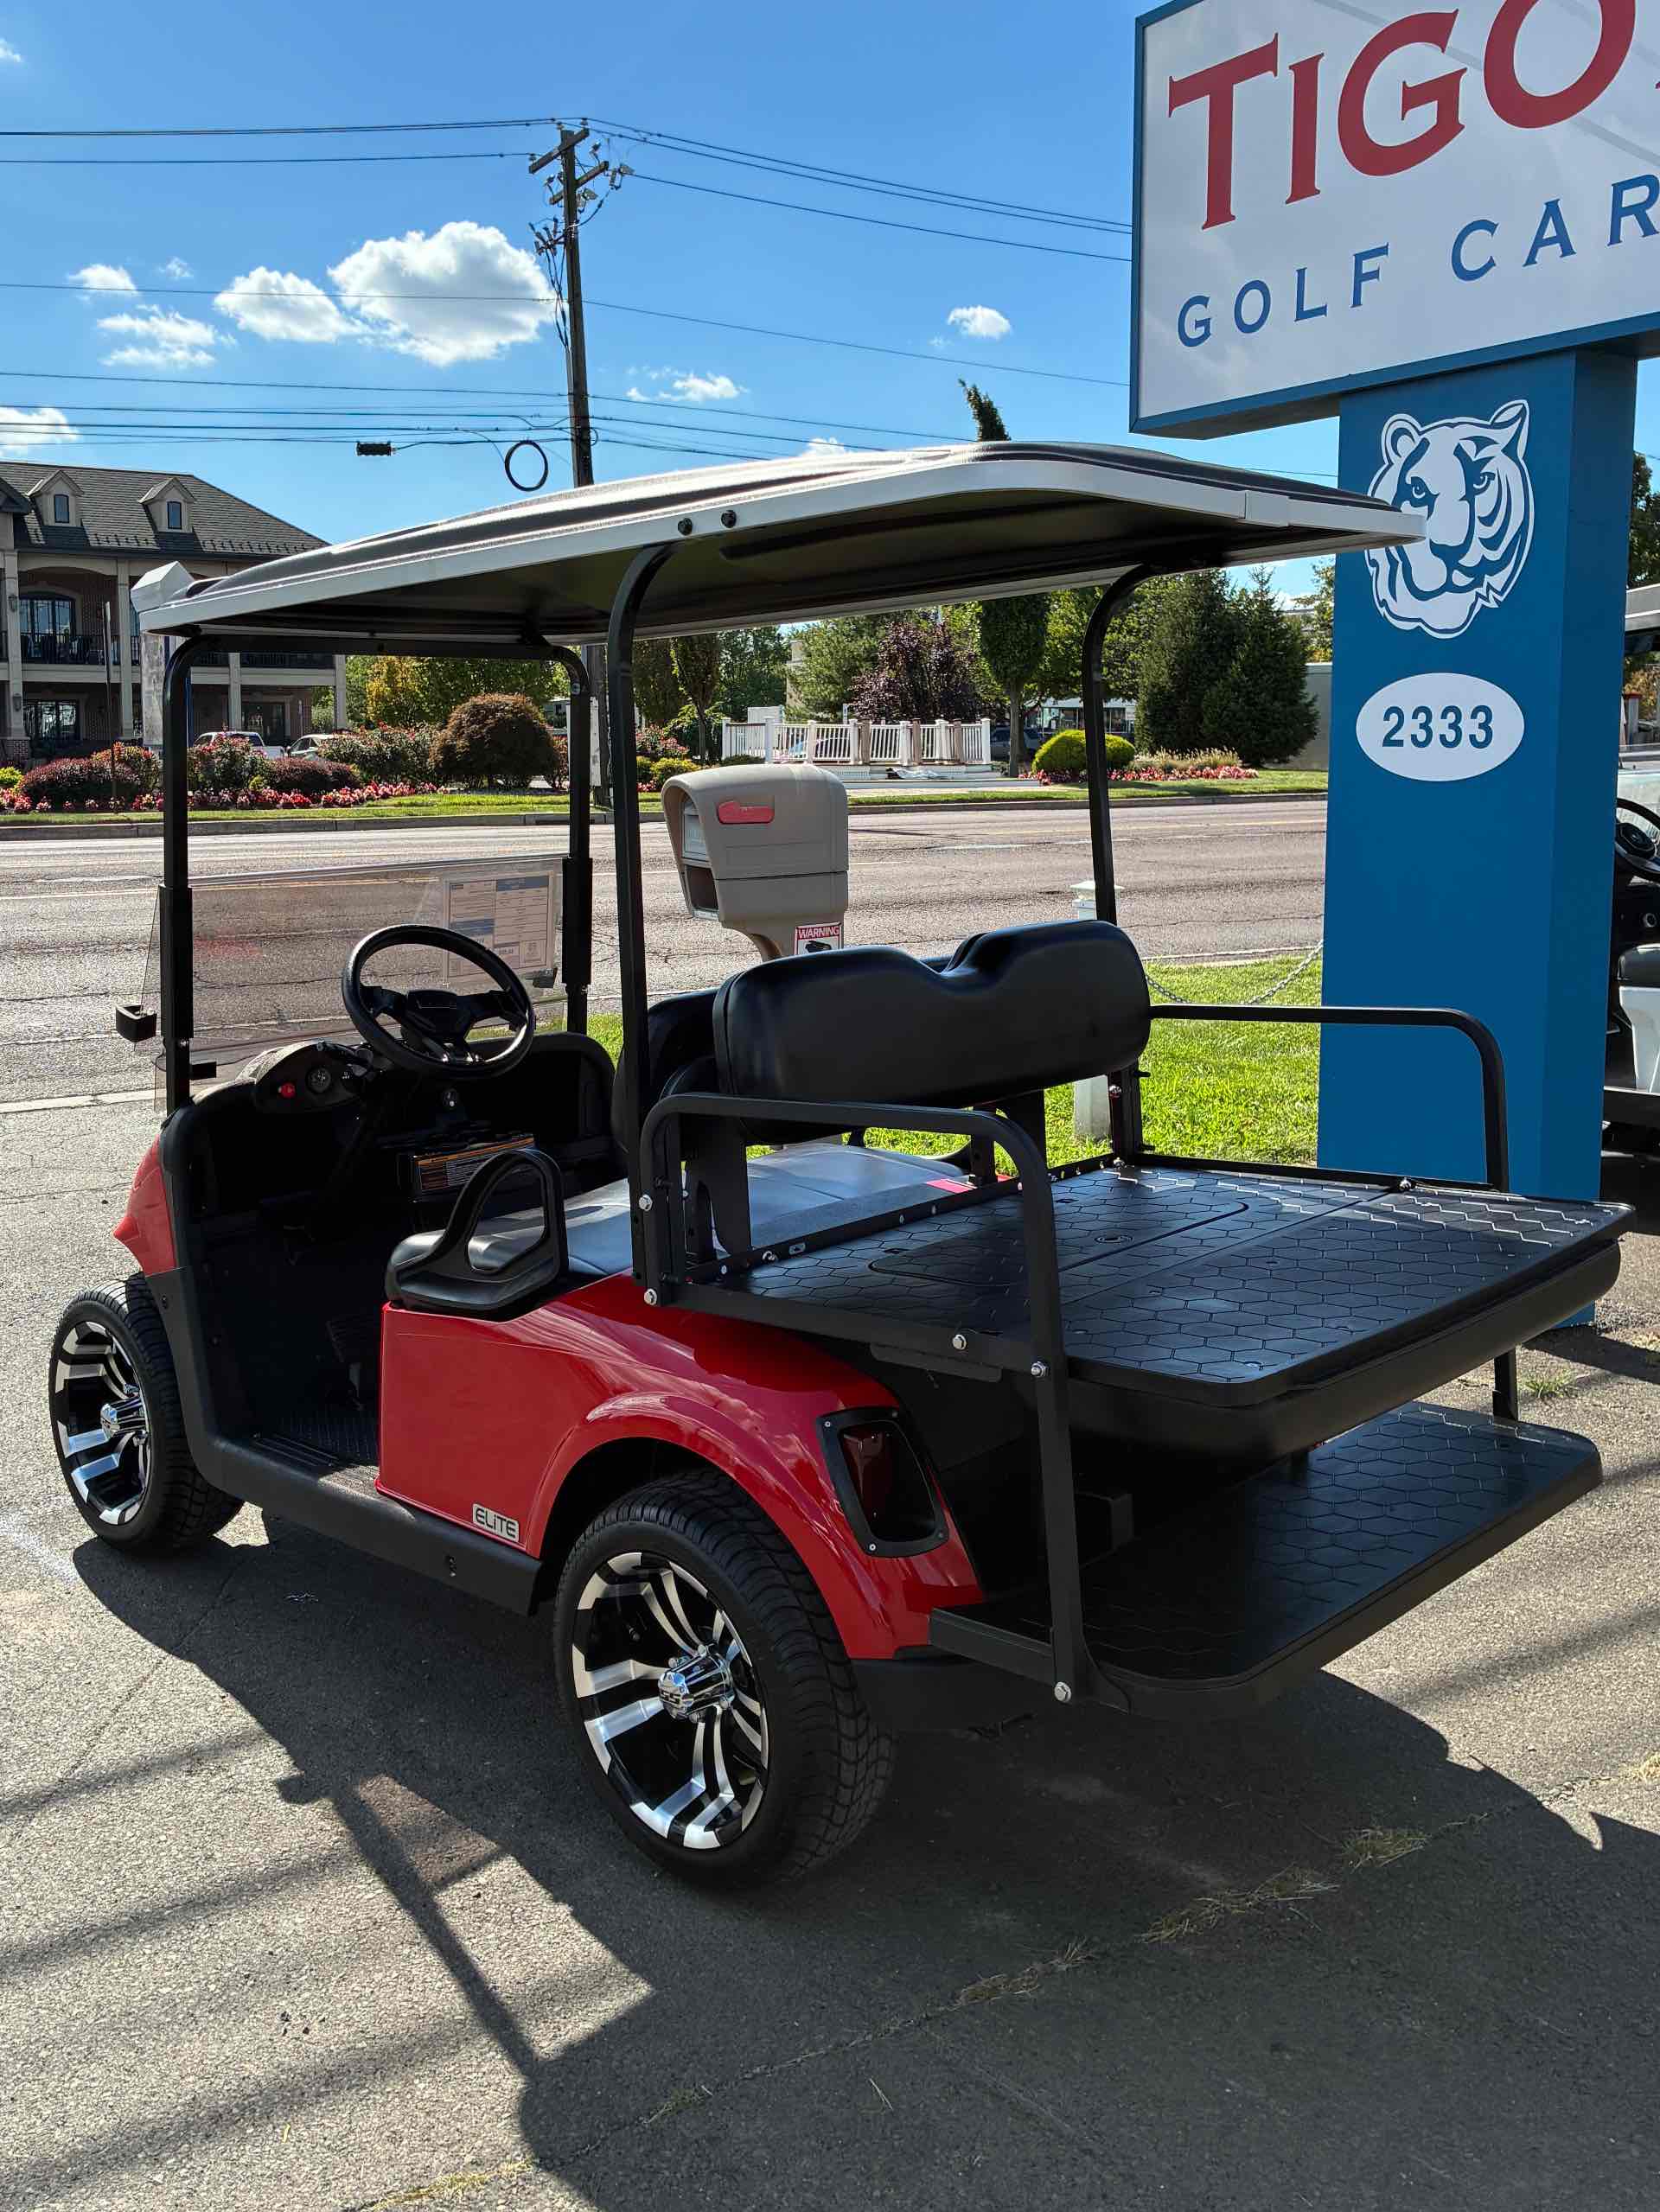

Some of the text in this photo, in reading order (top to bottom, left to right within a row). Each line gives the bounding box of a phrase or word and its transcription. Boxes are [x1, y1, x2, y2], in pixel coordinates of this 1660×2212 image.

[1168, 0, 1660, 230] TIGO
[1177, 174, 1660, 347] GOLF CAR
[1382, 704, 1494, 749] 2333
[798, 926, 840, 940] WARNING
